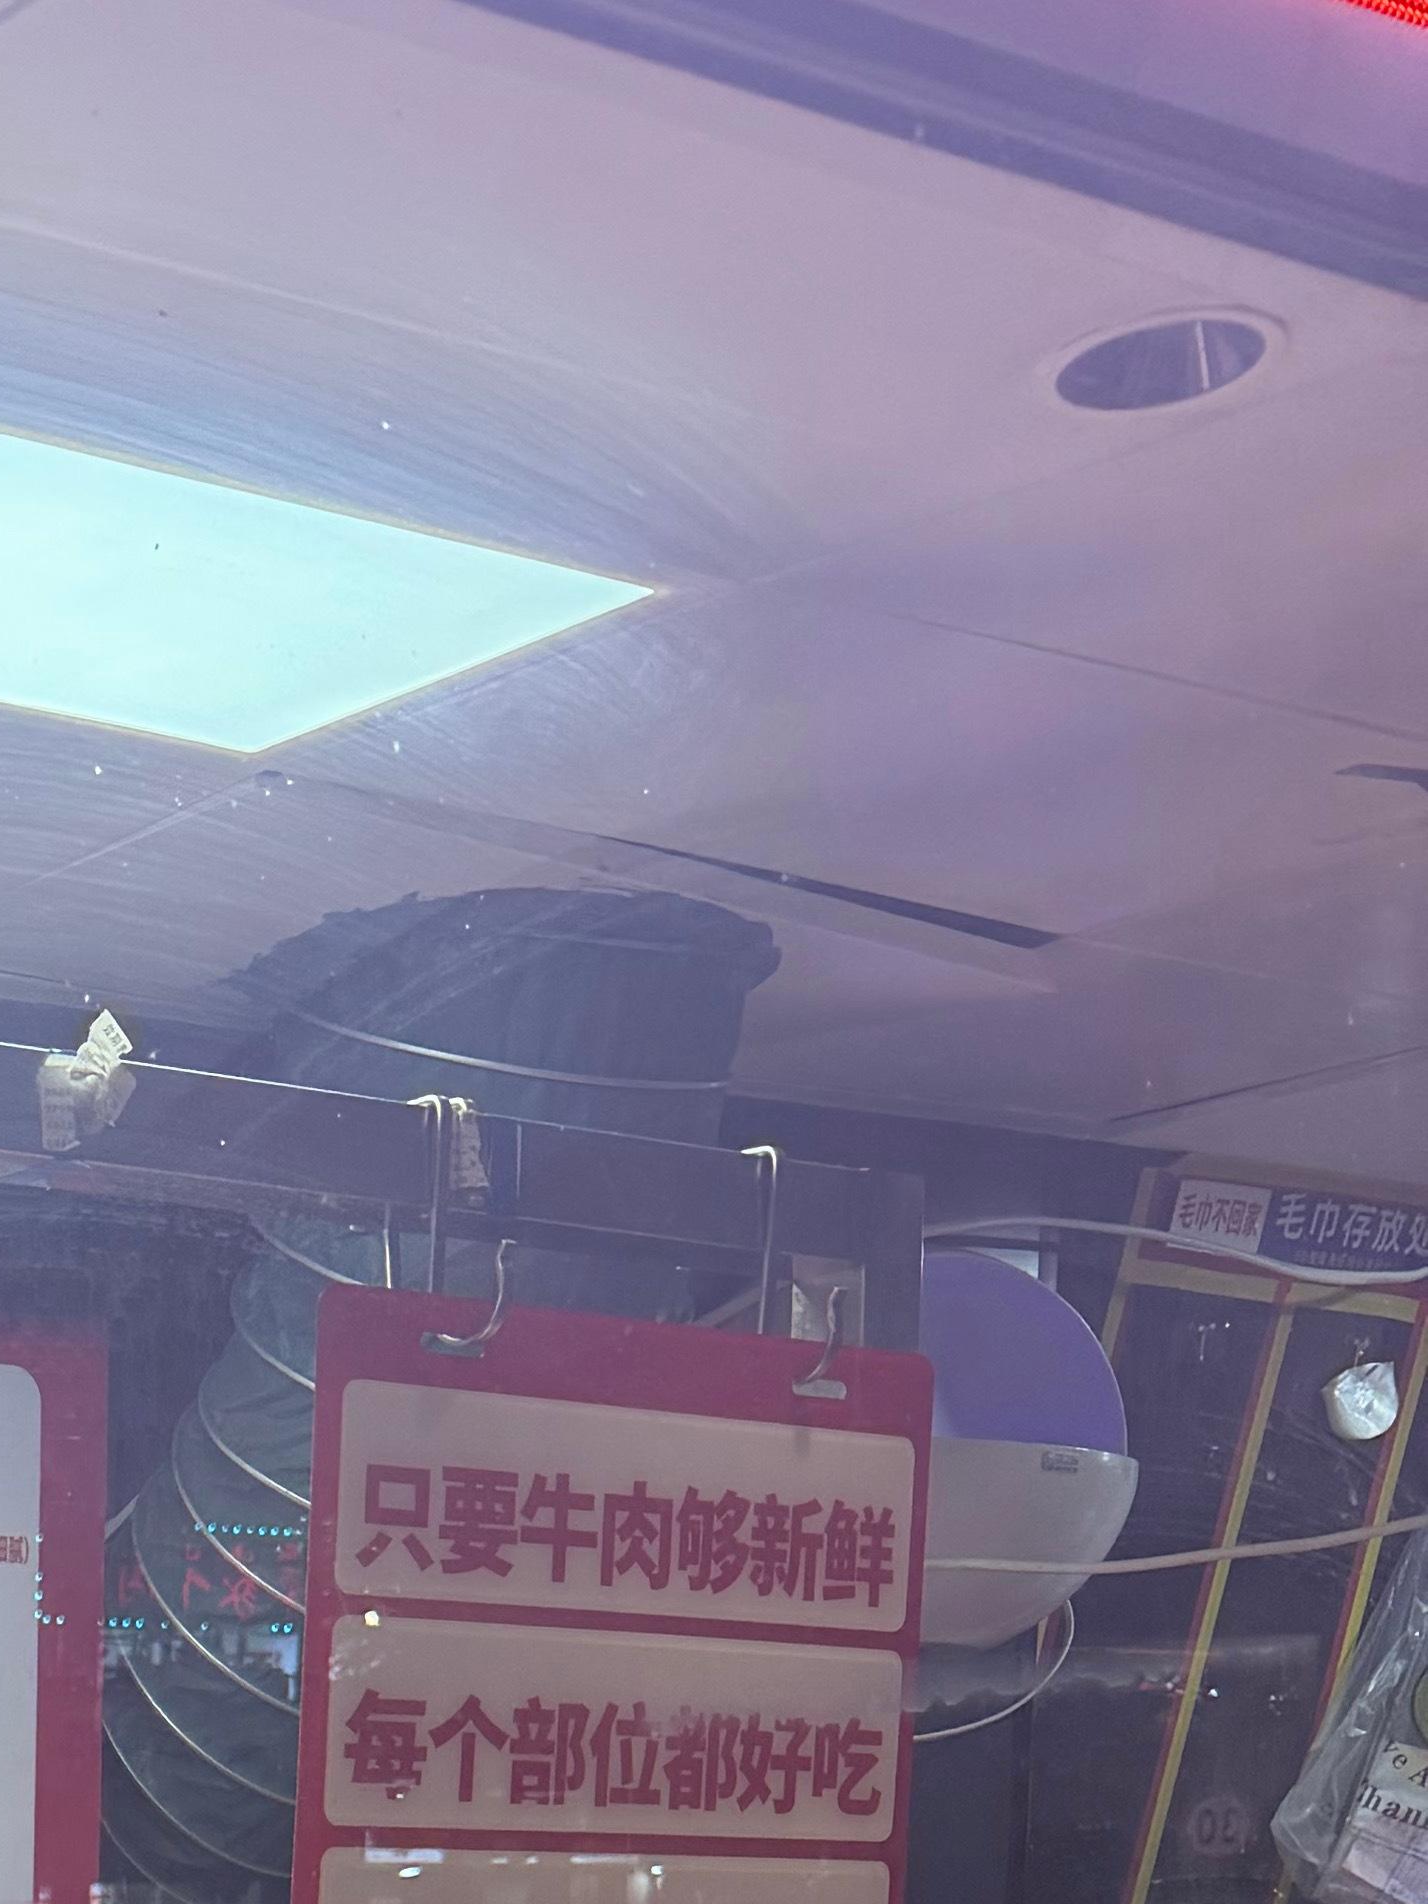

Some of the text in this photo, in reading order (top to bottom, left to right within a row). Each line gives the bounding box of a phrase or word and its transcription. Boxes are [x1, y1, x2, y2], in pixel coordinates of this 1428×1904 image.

[355, 1463, 896, 1608] 只要牛肉够新鲜
[345, 1688, 884, 1817] 每个部位都好吃
